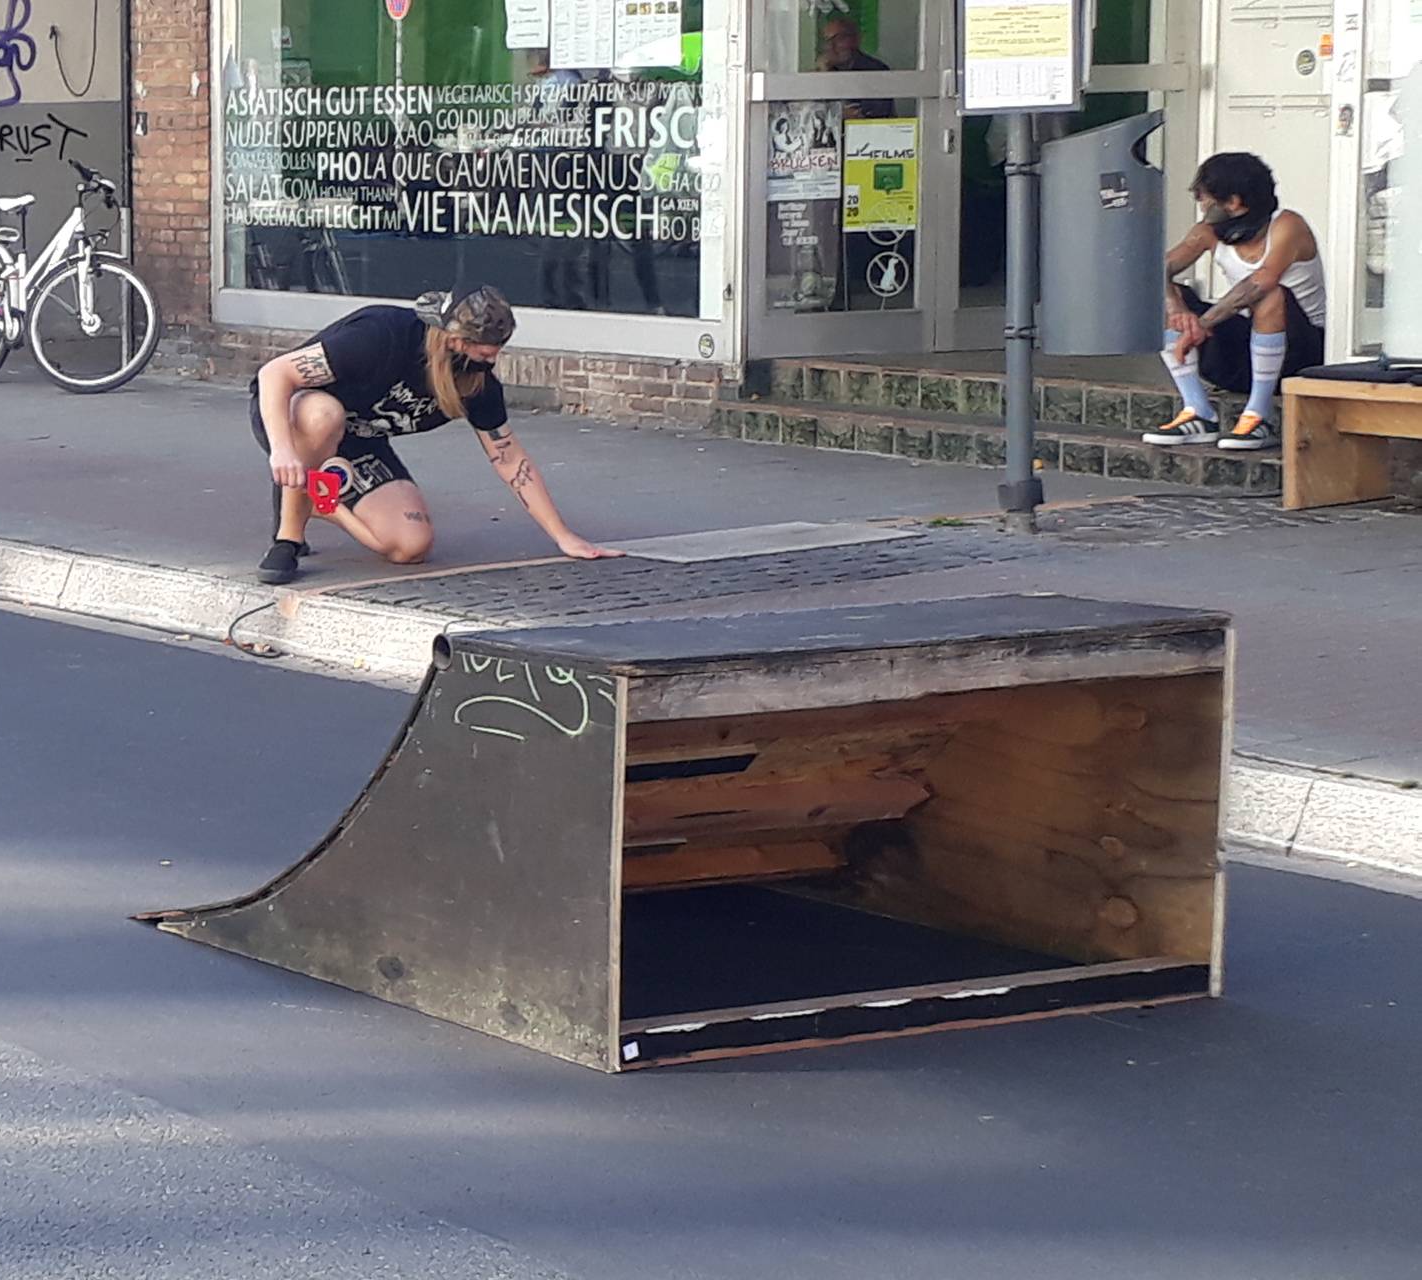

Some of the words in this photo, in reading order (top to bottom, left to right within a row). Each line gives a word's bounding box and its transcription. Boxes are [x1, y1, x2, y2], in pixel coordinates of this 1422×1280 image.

[225, 86, 321, 116] ASIATISCH
[325, 86, 368, 115] GUT
[373, 85, 432, 115] ESSEN
[436, 83, 522, 104] VEGETARISCH
[226, 121, 350, 148] NUDELSUPPEN
[352, 121, 390, 147] RAU
[393, 120, 433, 147] XAO
[513, 127, 592, 148] GEGRILLTES
[317, 151, 361, 181] PHO
[363, 152, 387, 180] LA
[392, 151, 432, 187] QUE
[435, 152, 656, 190] GAUMENGENUSS
[226, 174, 282, 201] SALAT
[281, 178, 318, 201] COM
[360, 186, 397, 202] THANH
[226, 204, 324, 228] HAUSGEMACHT
[324, 205, 383, 230] LEICHT
[400, 190, 659, 240] VIETNAMESISCH
